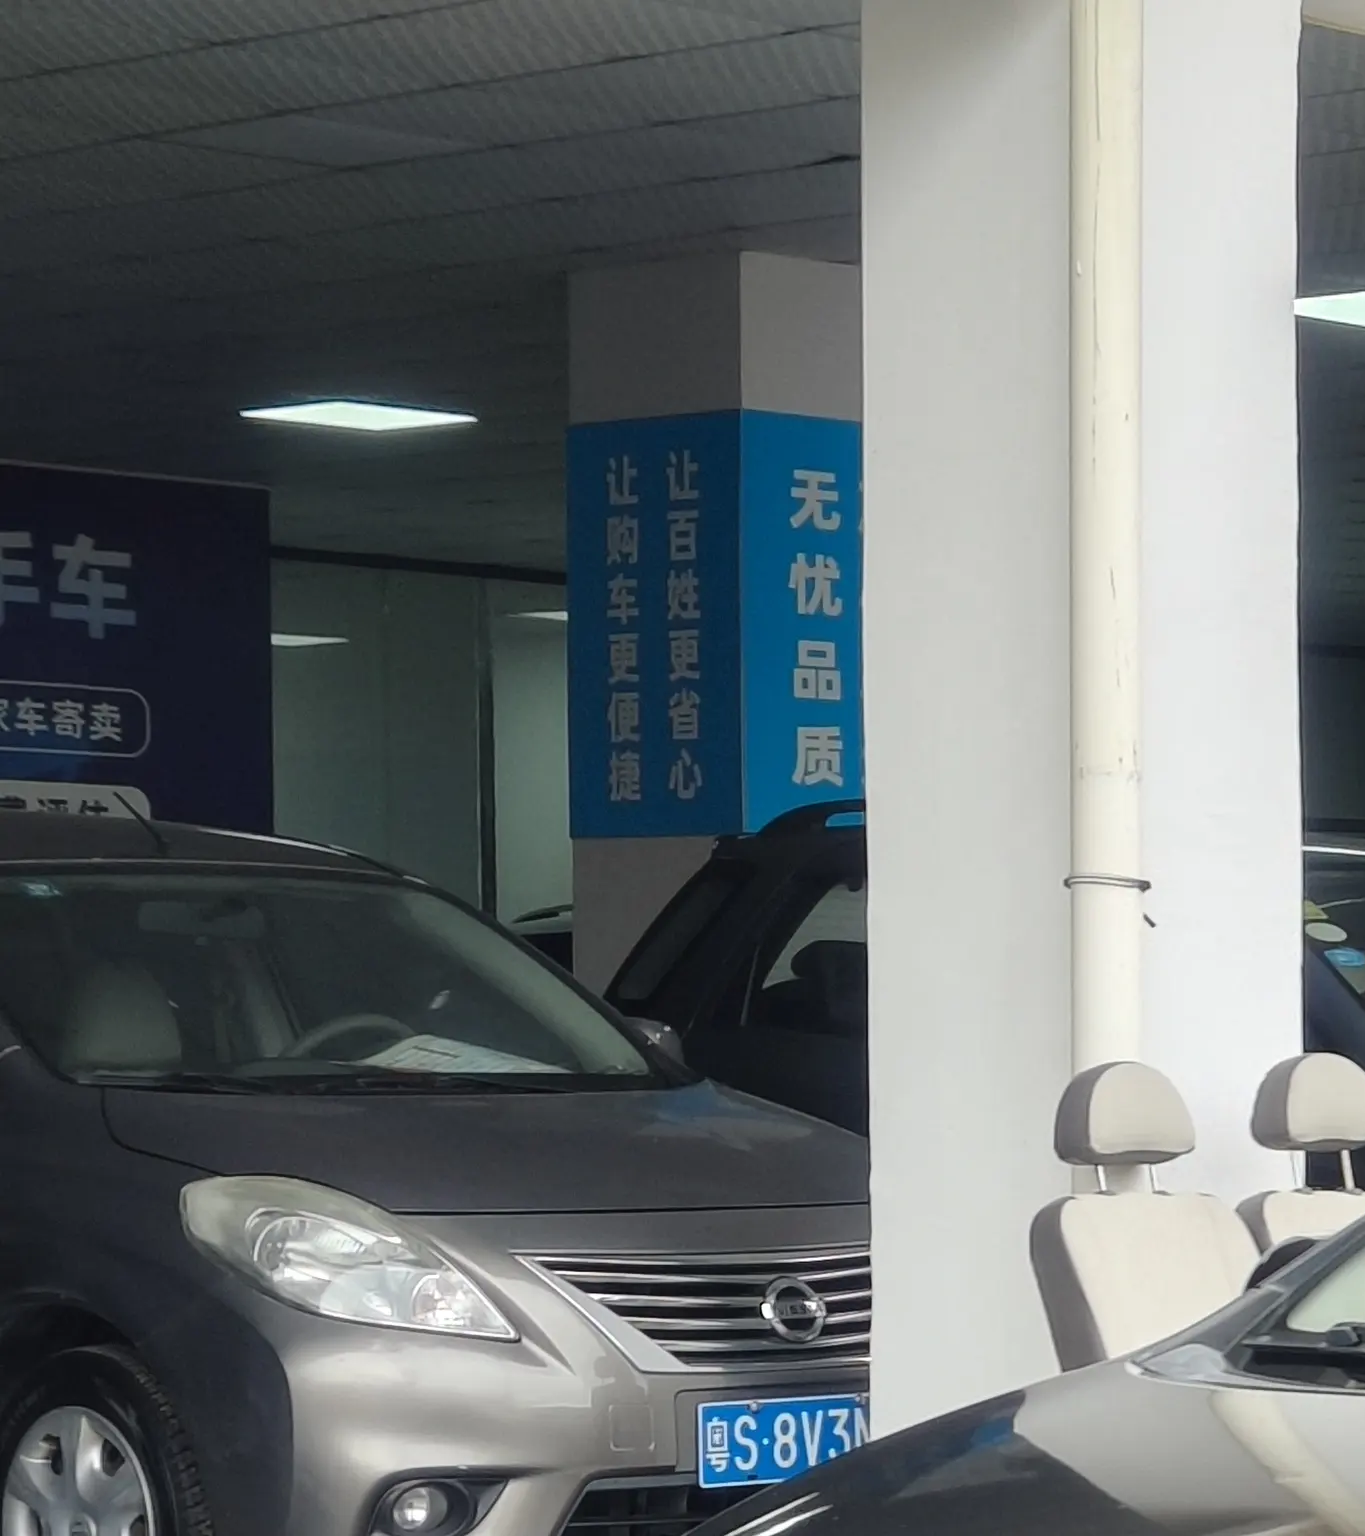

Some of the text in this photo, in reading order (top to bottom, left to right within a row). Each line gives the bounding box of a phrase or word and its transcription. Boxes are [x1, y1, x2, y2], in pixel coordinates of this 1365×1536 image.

[606, 455, 641, 801] 让购车更便捷
[666, 450, 702, 799] 让百姓更省心
[789, 469, 844, 787] 无忧品质
